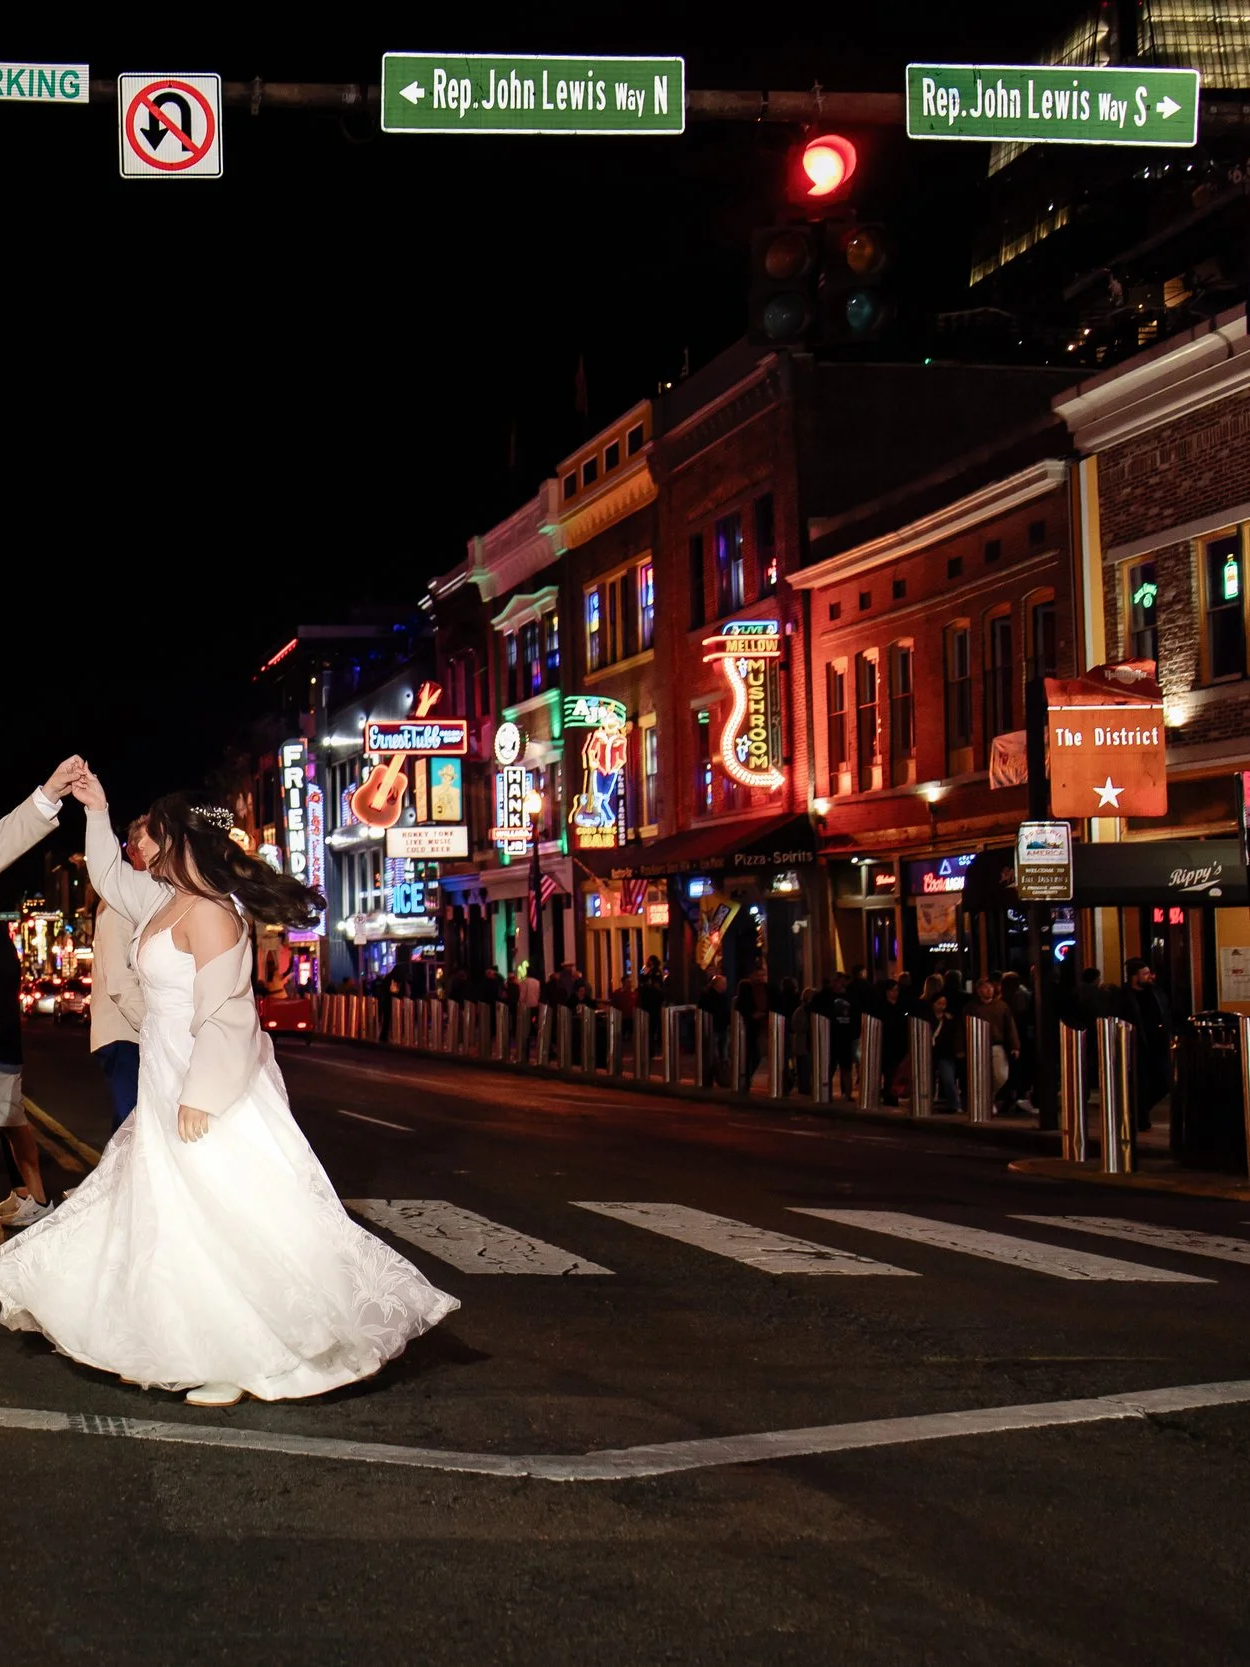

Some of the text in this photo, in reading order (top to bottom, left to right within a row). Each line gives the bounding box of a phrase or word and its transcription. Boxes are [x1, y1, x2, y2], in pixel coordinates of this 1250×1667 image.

[433, 68, 668, 118] Rep. John Lewis Way N
[922, 77, 1148, 129] Rep. John Lewis Way S
[725, 639, 778, 652] MELLOW
[747, 658, 769, 769] MUSHROOM
[370, 725, 441, 750] Ernest Tubb
[1055, 726, 1159, 747] The District
[508, 770, 522, 827] HANK
[579, 833, 616, 848] BAR
[734, 853, 766, 866] Pizza
[773, 850, 814, 865] Spirits
[1168, 860, 1222, 888] Rippy's
